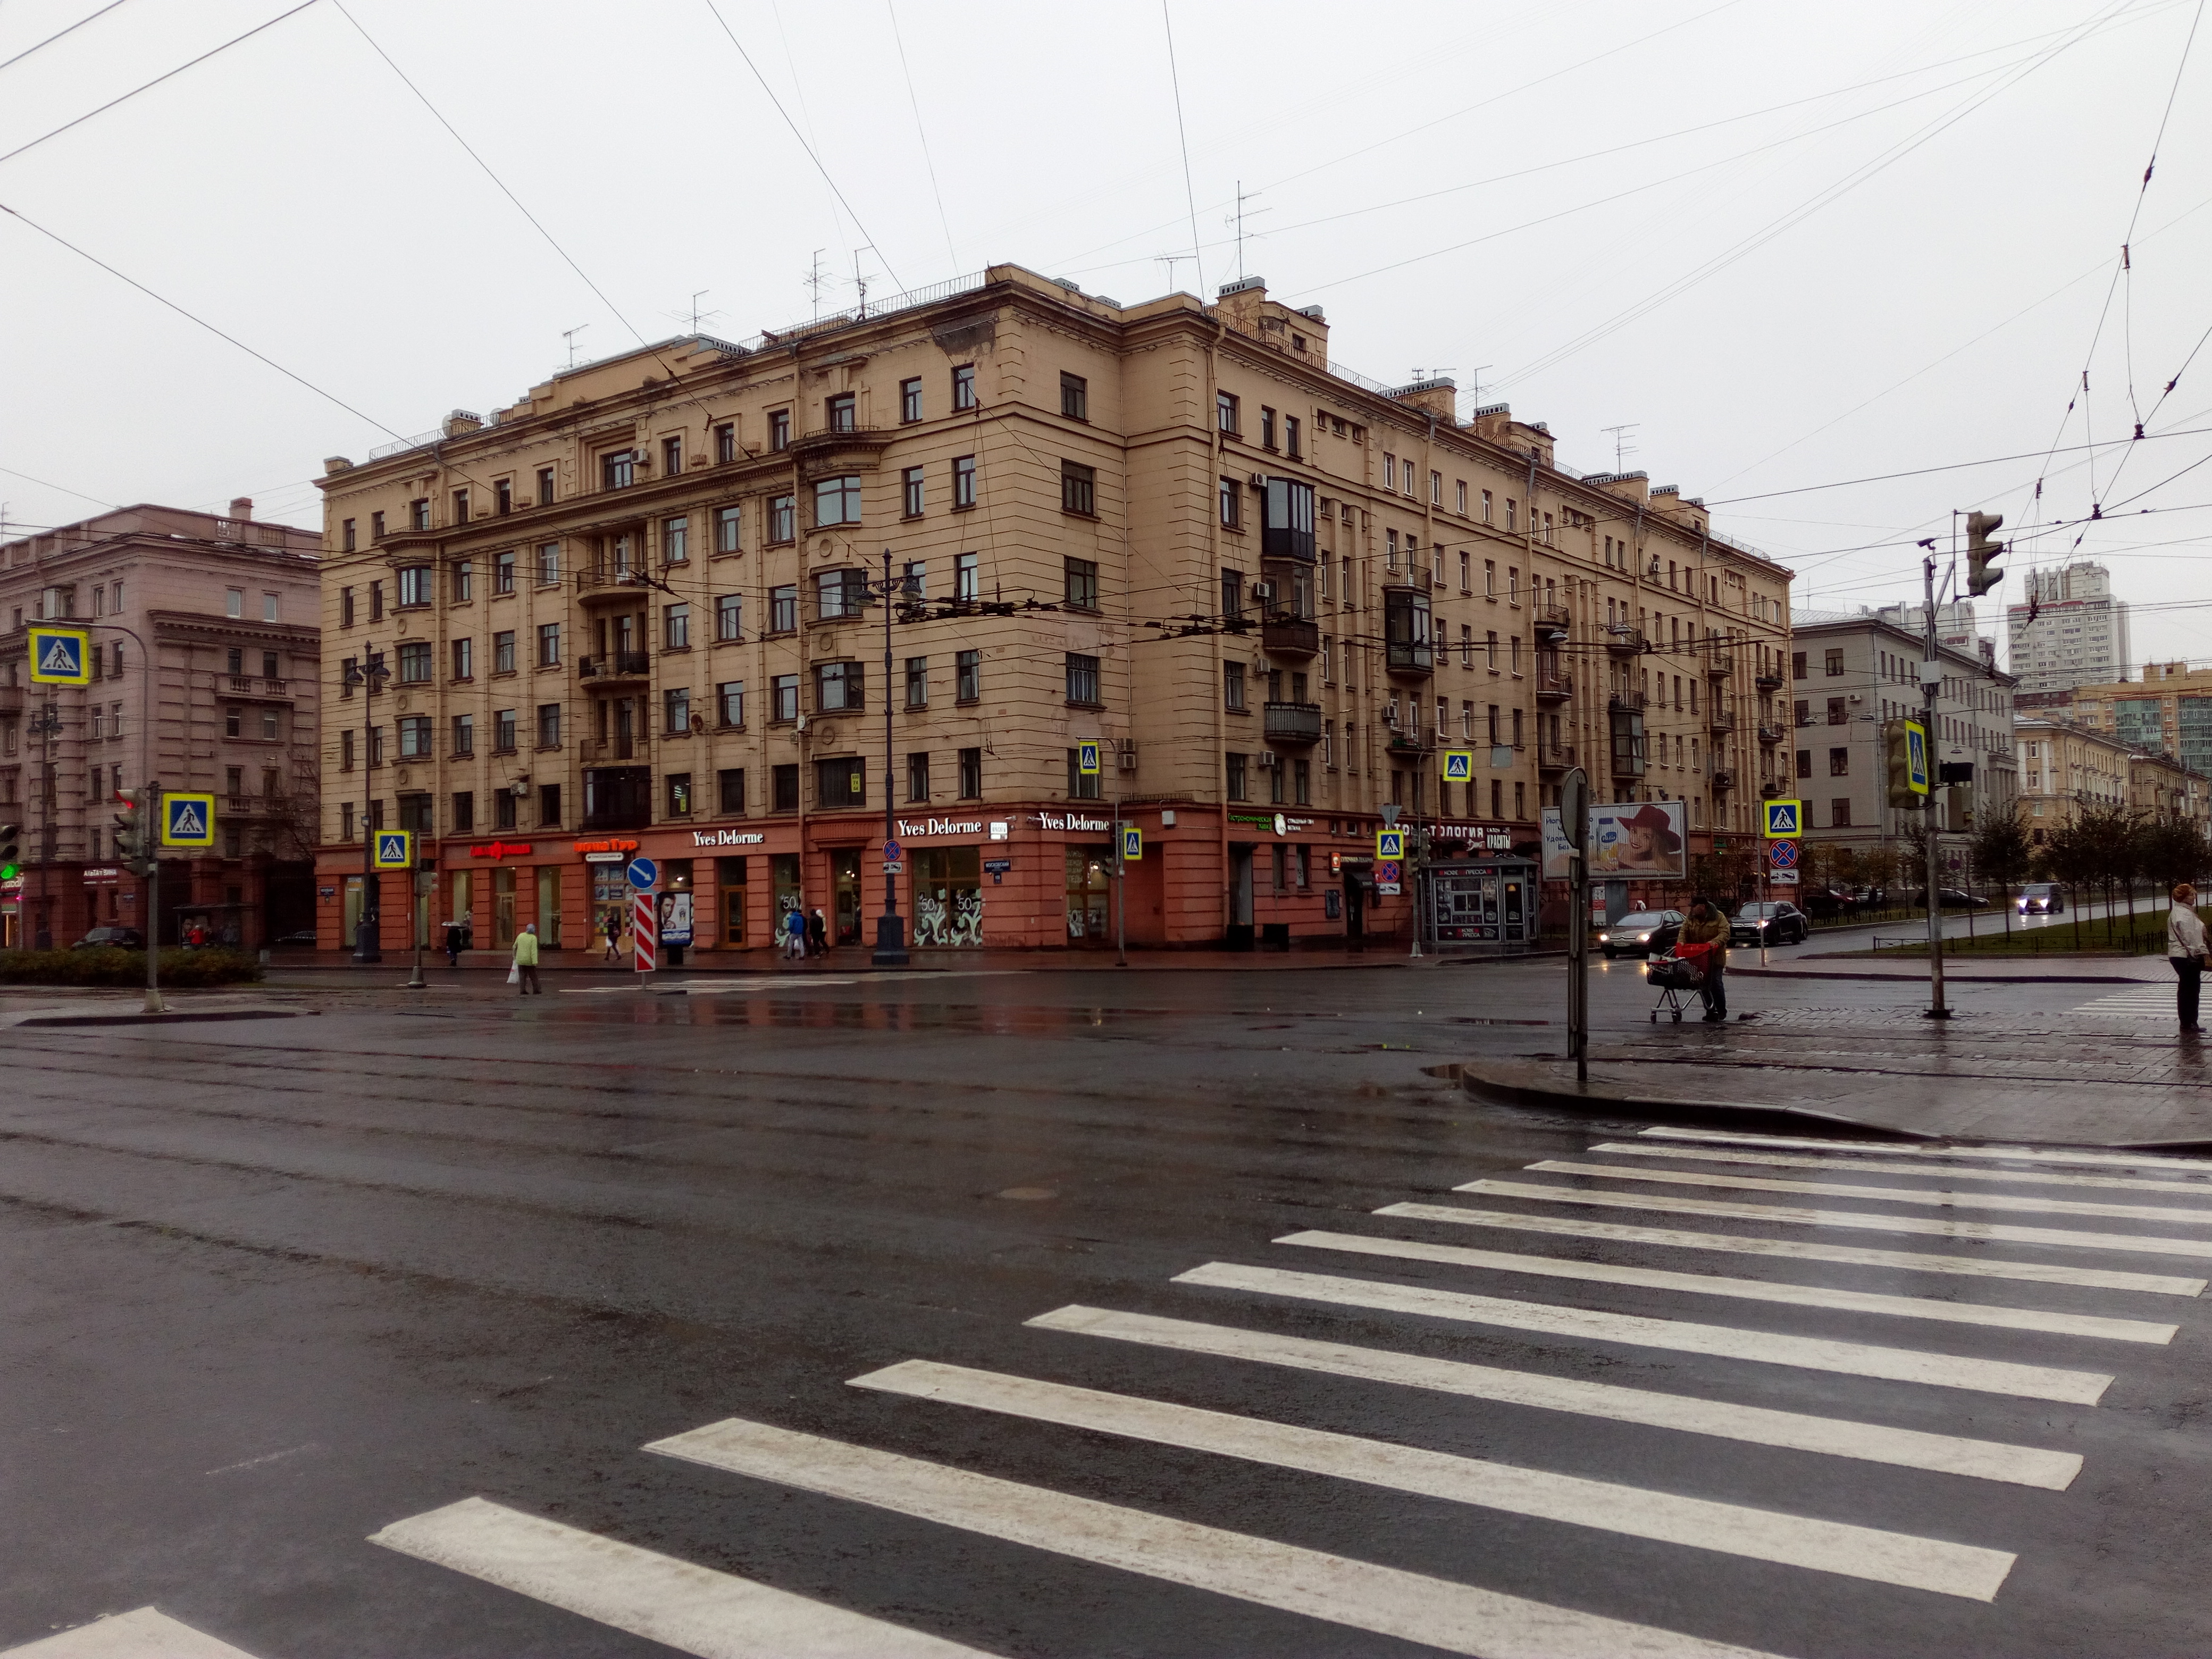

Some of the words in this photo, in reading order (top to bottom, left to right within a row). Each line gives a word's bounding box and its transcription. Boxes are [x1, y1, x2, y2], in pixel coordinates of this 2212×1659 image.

[898, 820, 925, 836] Yves
[928, 818, 982, 835] Delorme
[1040, 812, 1064, 829] Yves
[1067, 814, 1109, 830] Delorme
[693, 831, 716, 846] Yves
[718, 830, 763, 845] Delorme
[1487, 834, 1511, 849] КРАСОТЫ
